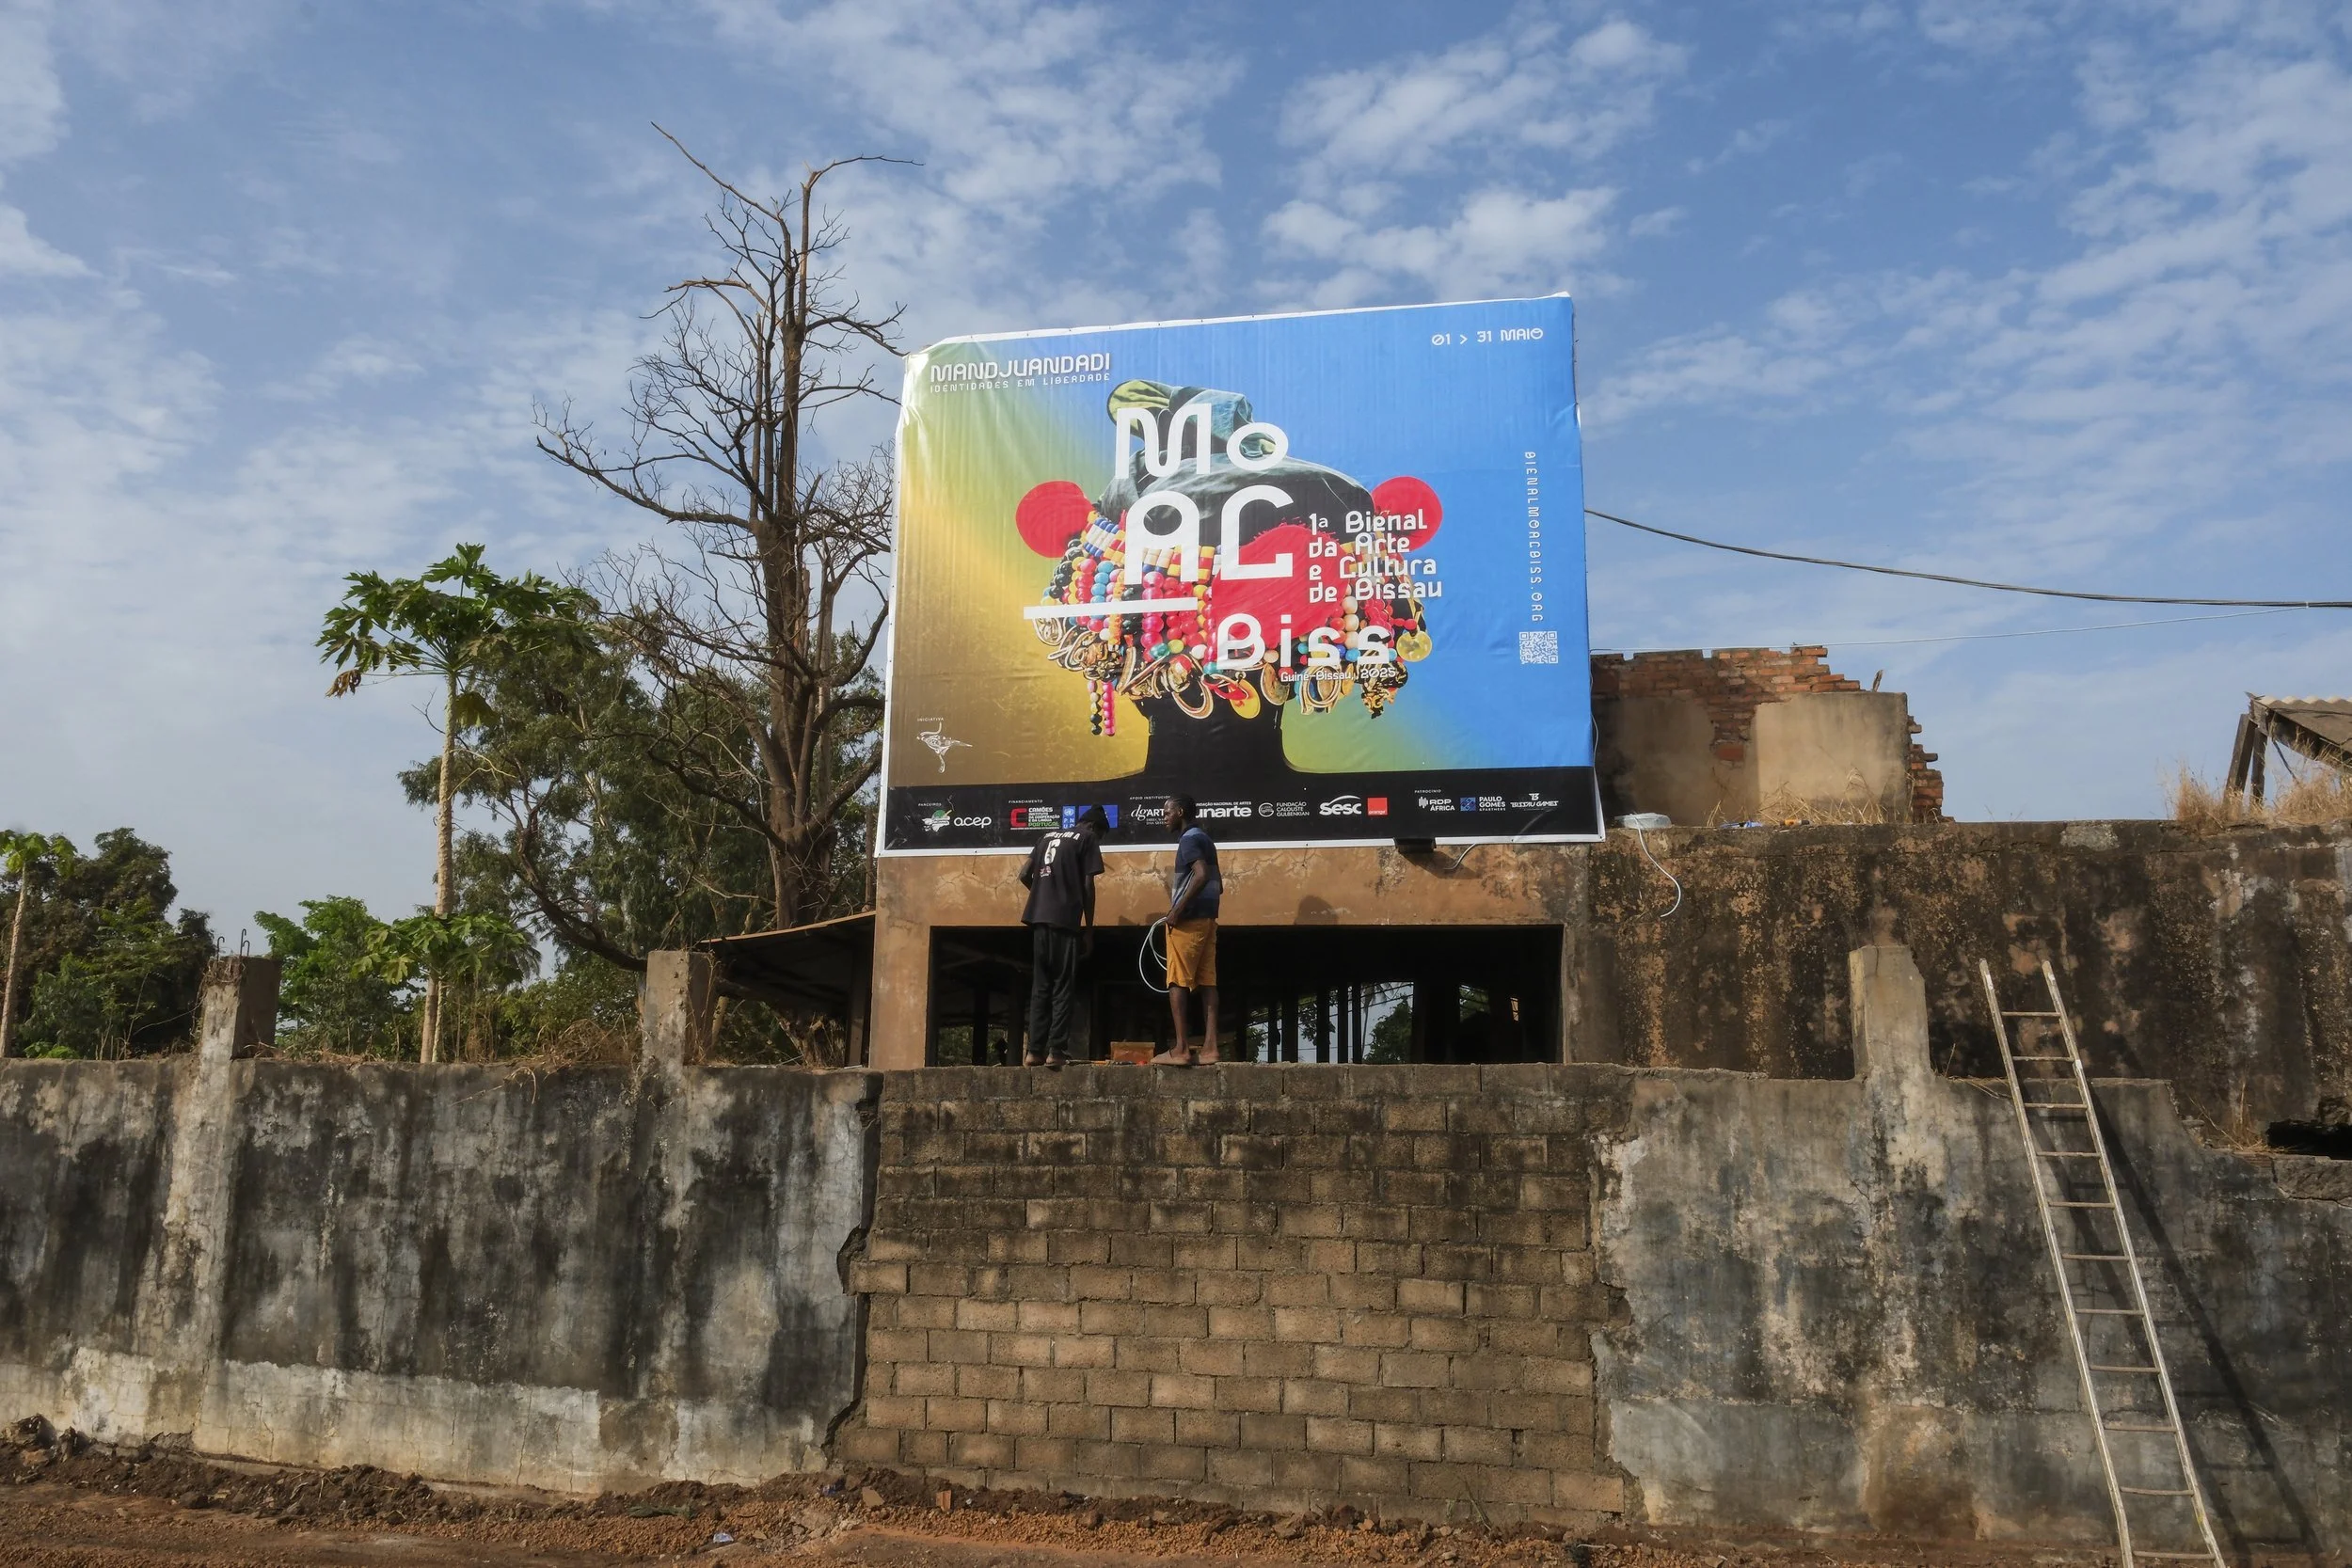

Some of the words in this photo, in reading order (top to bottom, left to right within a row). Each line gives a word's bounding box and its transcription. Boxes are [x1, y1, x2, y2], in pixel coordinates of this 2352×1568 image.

[1431, 333, 1451, 345] 01
[1476, 330, 1492, 342] 31
[1500, 327, 1544, 341] MAIO
[930, 353, 1110, 383] MANDJUANDADI
[930, 381, 1009, 393] IDENTIDADES
[1017, 378, 1035, 388] EM
[1042, 372, 1110, 386] LIBERDADE
[1115, 403, 1289, 480] Mo
[1345, 508, 1428, 534] Bienal
[1123, 484, 1295, 586] AC
[1309, 537, 1337, 558] da
[1355, 531, 1410, 556] Arte
[1524, 451, 1544, 622] BIENALMOACBISS.ORG
[1309, 563, 1322, 580] e
[1339, 554, 1437, 579] Cultura
[1309, 581, 1337, 603] de
[1355, 577, 1442, 602] Bissau
[1216, 612, 1391, 671] Biss
[1360, 667, 1397, 679] 2025
[953, 816, 992, 828] acep
